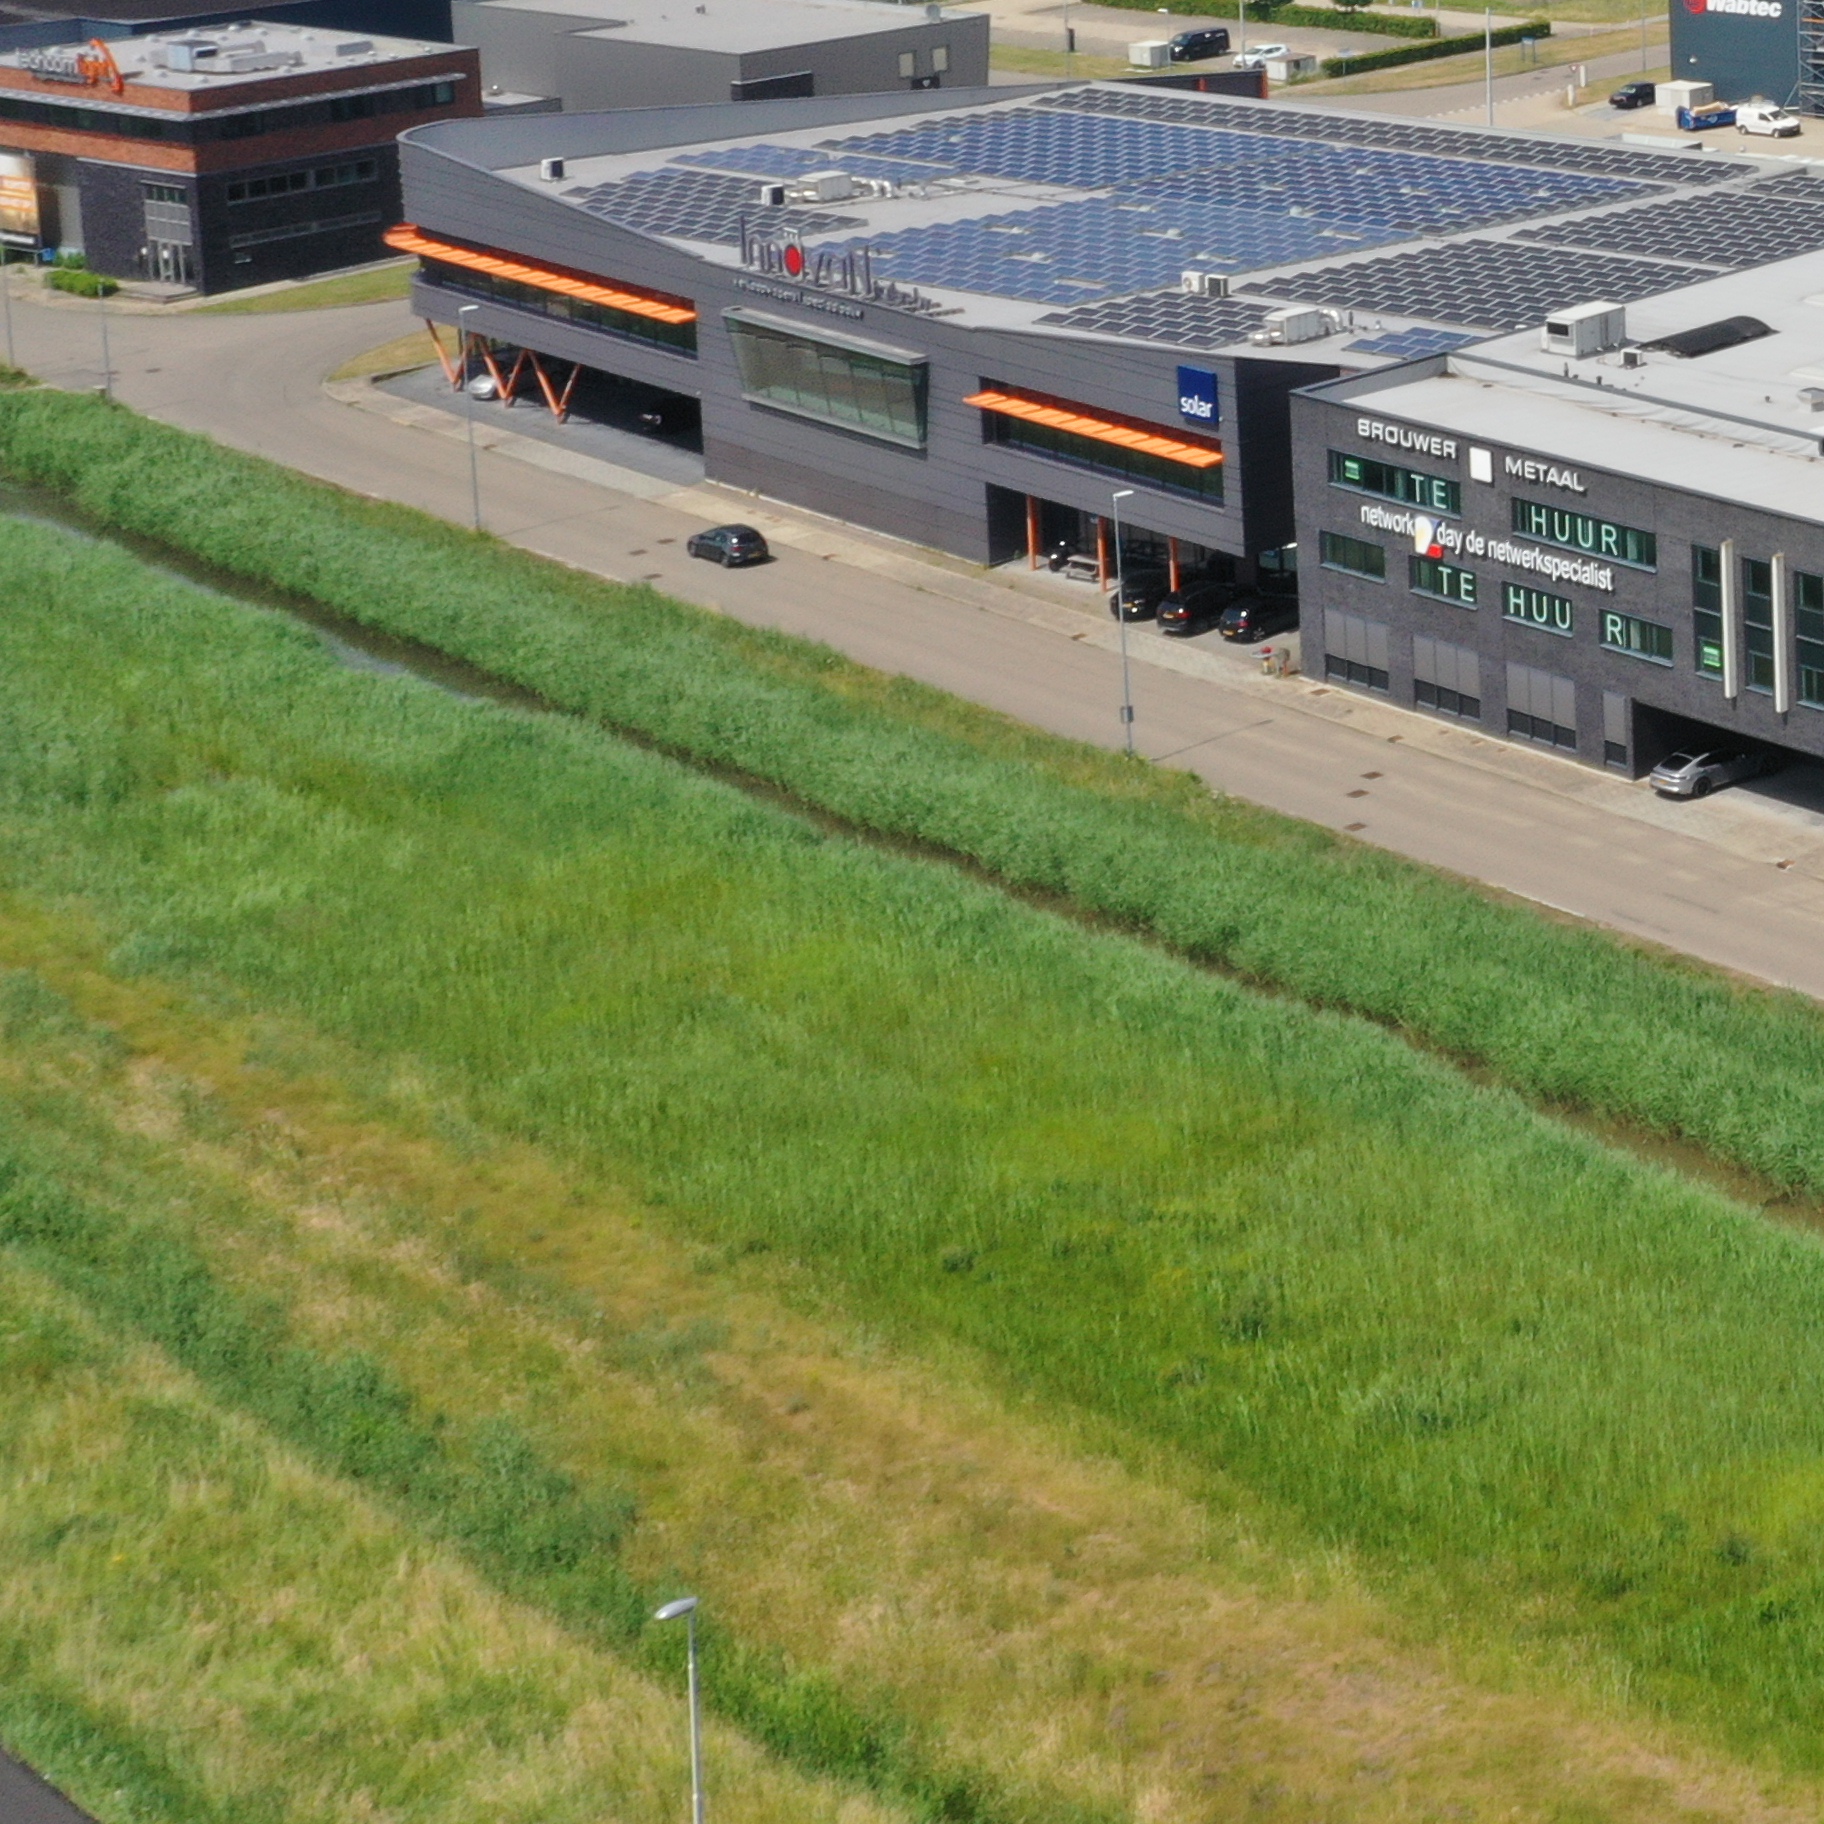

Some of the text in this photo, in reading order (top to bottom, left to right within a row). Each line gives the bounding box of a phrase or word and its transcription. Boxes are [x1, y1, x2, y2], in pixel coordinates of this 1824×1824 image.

[1180, 394, 1213, 418] solar
[1357, 418, 1585, 492] BROUWER METAAL
[1411, 474, 1619, 556] TE HUUR
[1438, 566, 1475, 602] TE
[1465, 530, 1485, 556] de
[1487, 539, 1614, 592] netwerkspecialist
